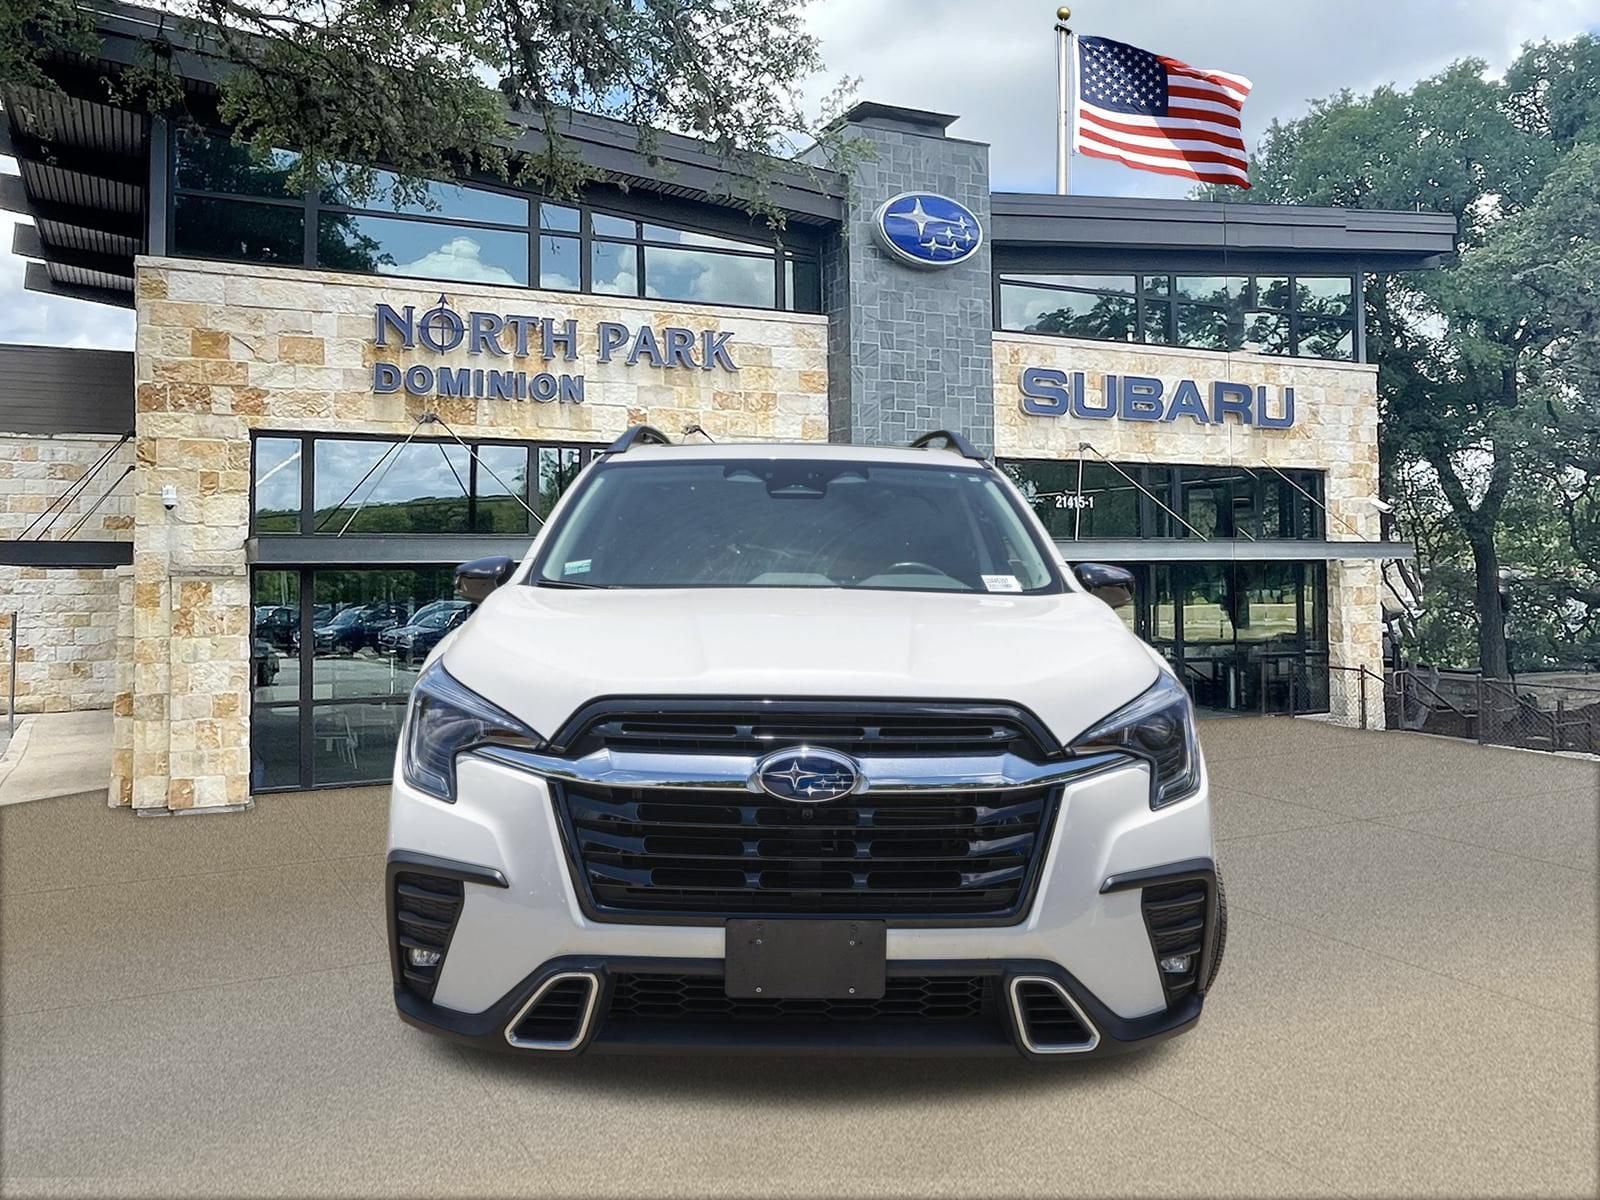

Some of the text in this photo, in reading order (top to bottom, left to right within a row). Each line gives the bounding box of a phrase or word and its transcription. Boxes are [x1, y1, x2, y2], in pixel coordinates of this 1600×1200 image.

[374, 294, 741, 372] NORTH PARK
[373, 362, 585, 403] DOMINION
[1019, 367, 1295, 429] SUBARU
